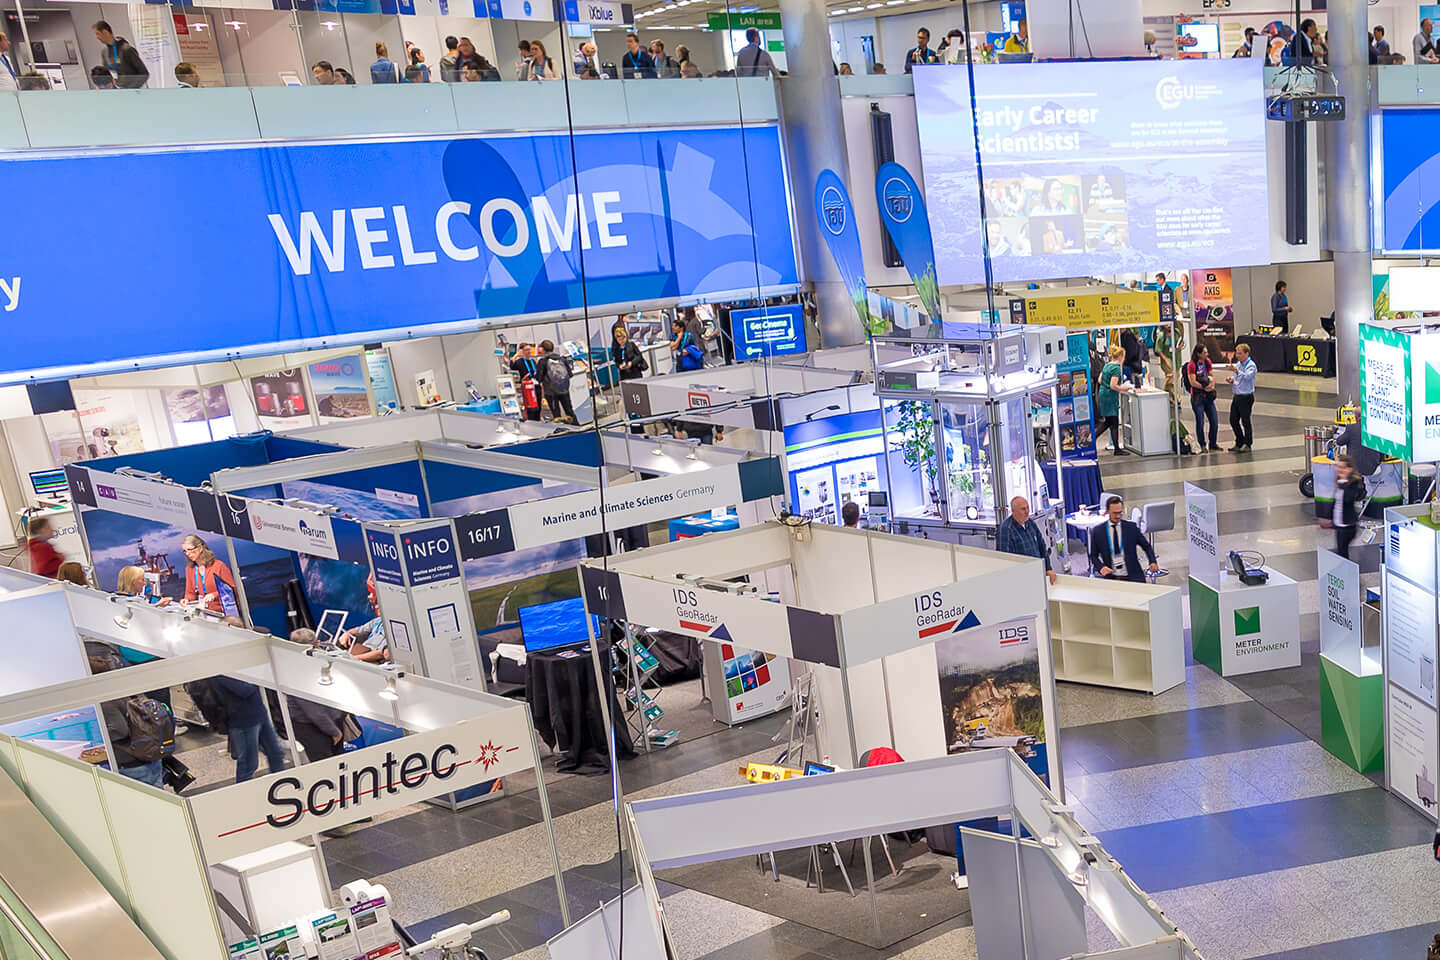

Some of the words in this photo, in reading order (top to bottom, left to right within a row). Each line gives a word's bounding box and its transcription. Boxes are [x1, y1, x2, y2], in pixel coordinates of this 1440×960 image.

[740, 17, 755, 26] LAN
[757, 17, 773, 26] area
[1163, 84, 1195, 101] EGU
[1029, 105, 1099, 127] Career
[268, 190, 628, 276] WELCOME
[1203, 286, 1221, 296] AXIS
[1367, 358, 1395, 375] MEASURE
[1374, 371, 1385, 382] THE
[632, 393, 641, 405] 19
[1367, 394, 1405, 416] ATMOSPHERE
[1369, 407, 1402, 426] CONTINUUM
[76, 481, 85, 493] 14
[541, 512, 577, 526] Marine
[579, 507, 597, 519] and
[636, 492, 674, 507] Sciences
[675, 483, 715, 500] Germany
[231, 512, 241, 525] 16
[467, 525, 501, 544] 16/17
[1189, 523, 1214, 544] HYDRAULIC
[1190, 535, 1216, 557] PROPERTIES
[1327, 572, 1345, 590] TEROS
[672, 588, 698, 607] IDS
[914, 591, 943, 613] IDS
[1327, 586, 1340, 600] SOIL
[676, 605, 719, 625] GeoRadar
[915, 603, 966, 627] GeoRadar
[1328, 599, 1347, 616] WATER
[1328, 611, 1353, 632] SENSING
[999, 626, 1029, 640] IDS
[1235, 638, 1262, 649] METER
[1236, 642, 1290, 656] ENVIRONMENT
[265, 743, 457, 829] Scintec
